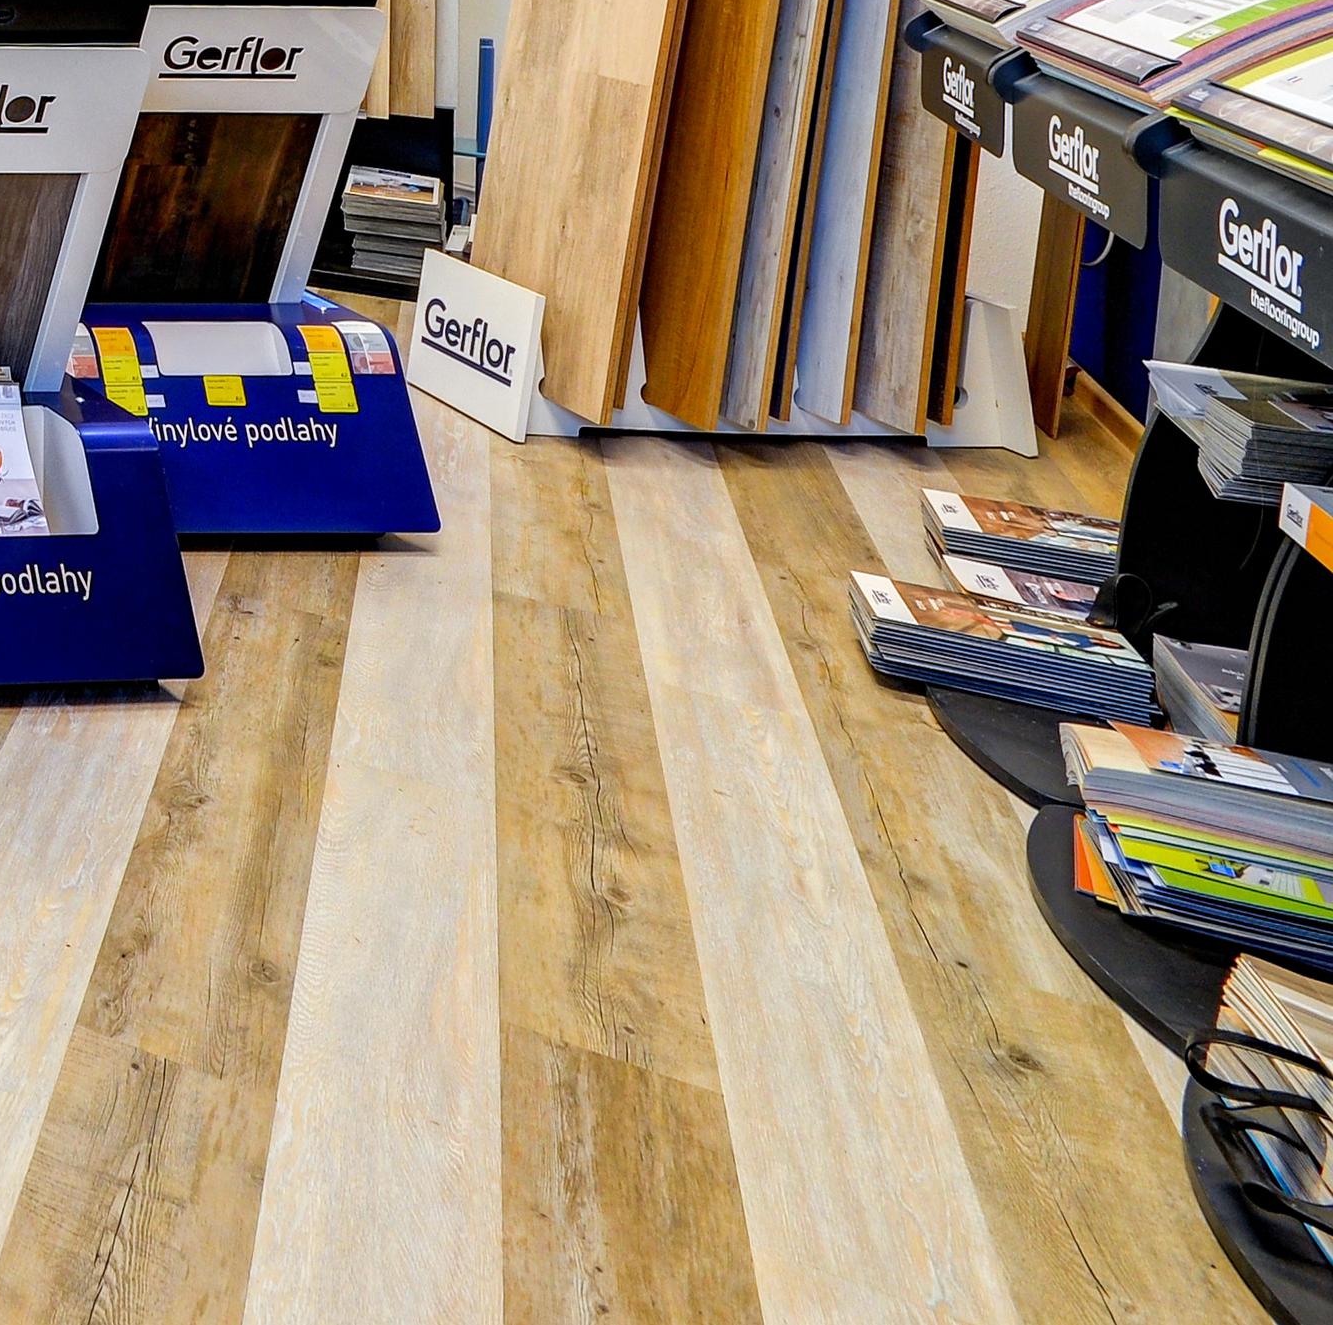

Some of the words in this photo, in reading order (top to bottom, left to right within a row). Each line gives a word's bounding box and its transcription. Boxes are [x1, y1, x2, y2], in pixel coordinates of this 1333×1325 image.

[164, 35, 304, 74] Gerflor
[943, 57, 975, 108] Gerflor
[1048, 114, 1100, 180] Gerflor
[1218, 197, 1303, 297] Gerflor
[424, 297, 516, 374] Gerflor
[245, 416, 338, 448] podlahy
